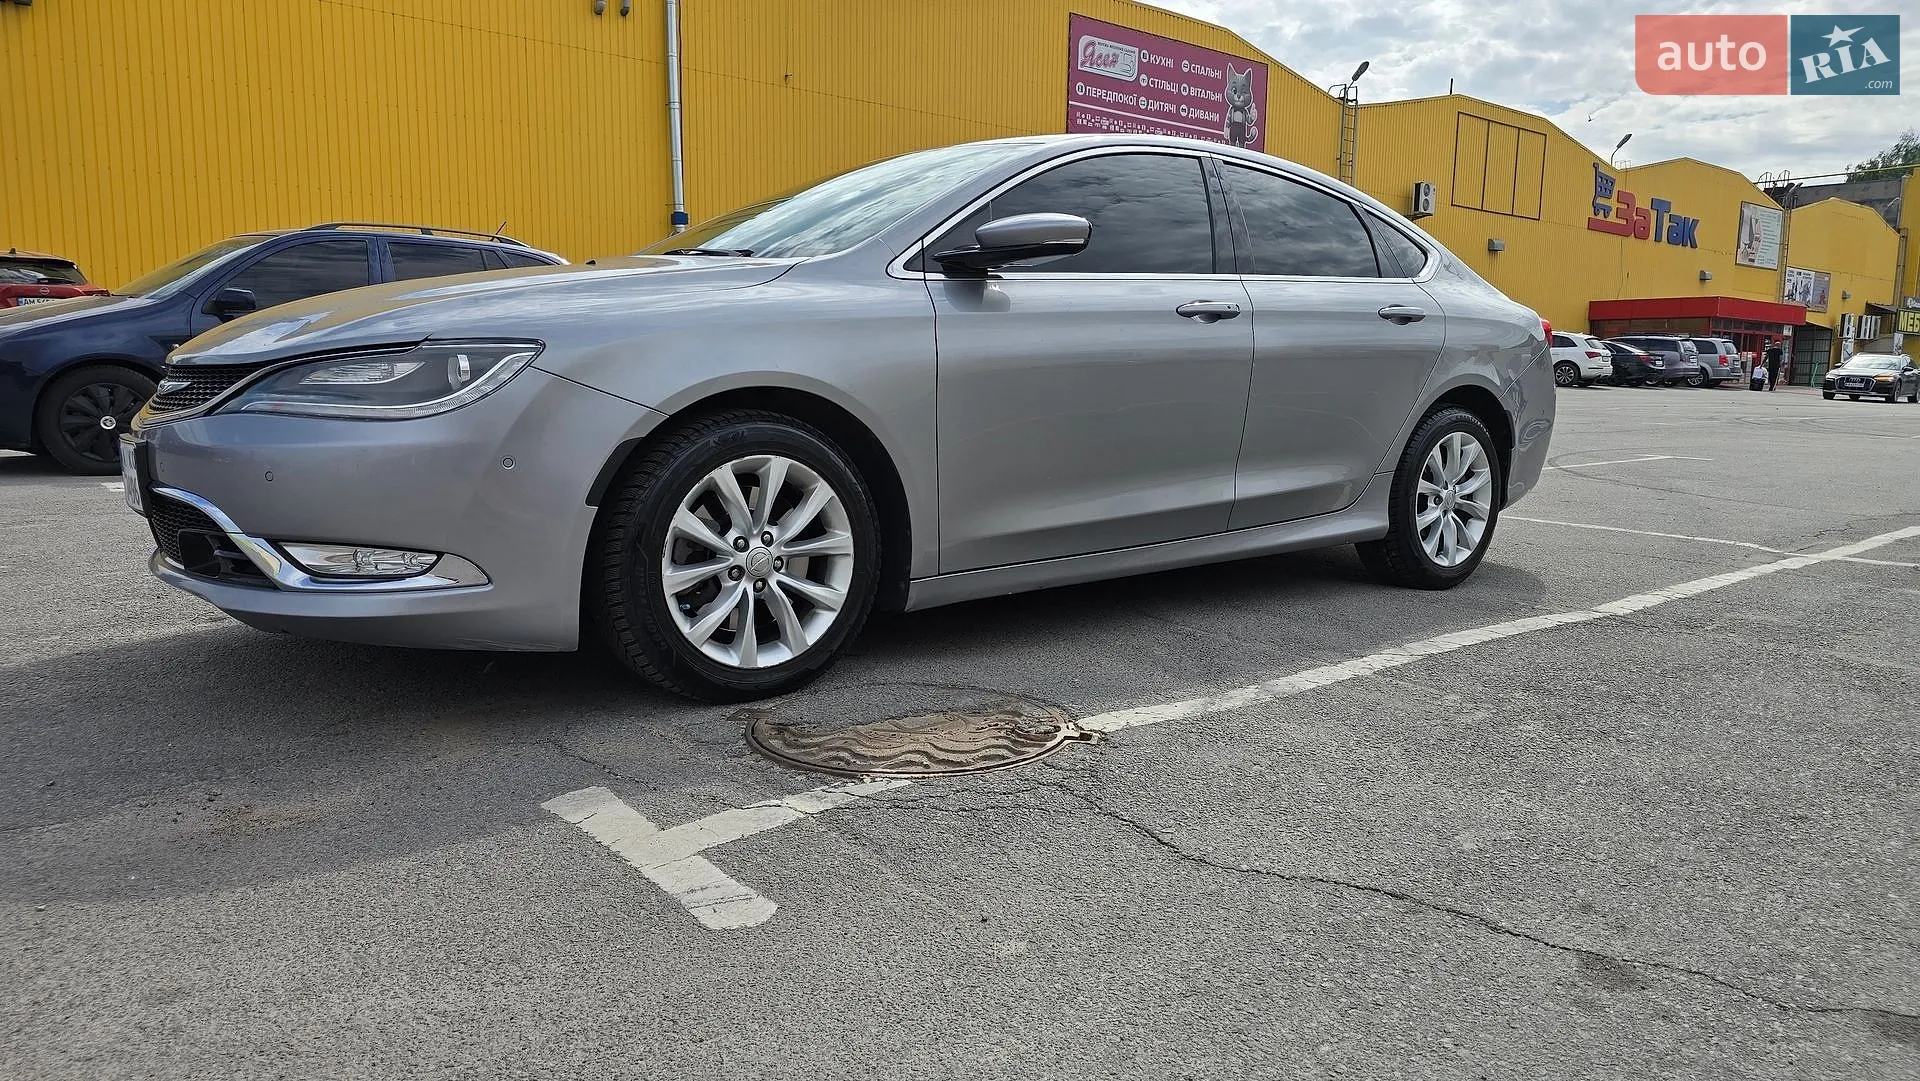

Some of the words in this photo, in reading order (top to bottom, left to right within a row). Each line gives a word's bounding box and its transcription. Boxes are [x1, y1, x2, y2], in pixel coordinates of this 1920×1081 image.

[1150, 53, 1174, 69] КУХНІ
[1190, 63, 1222, 80] СПАЛЬНІ
[1148, 77, 1179, 95] СТІЛЬЦІ
[1085, 86, 1138, 106] ПЕРЕДПОКОЇ
[1190, 88, 1223, 103] ВІТАЛЬНІ
[1147, 98, 1177, 115] ДИТЯЧІ
[1188, 108, 1220, 123] ДИВАНИ
